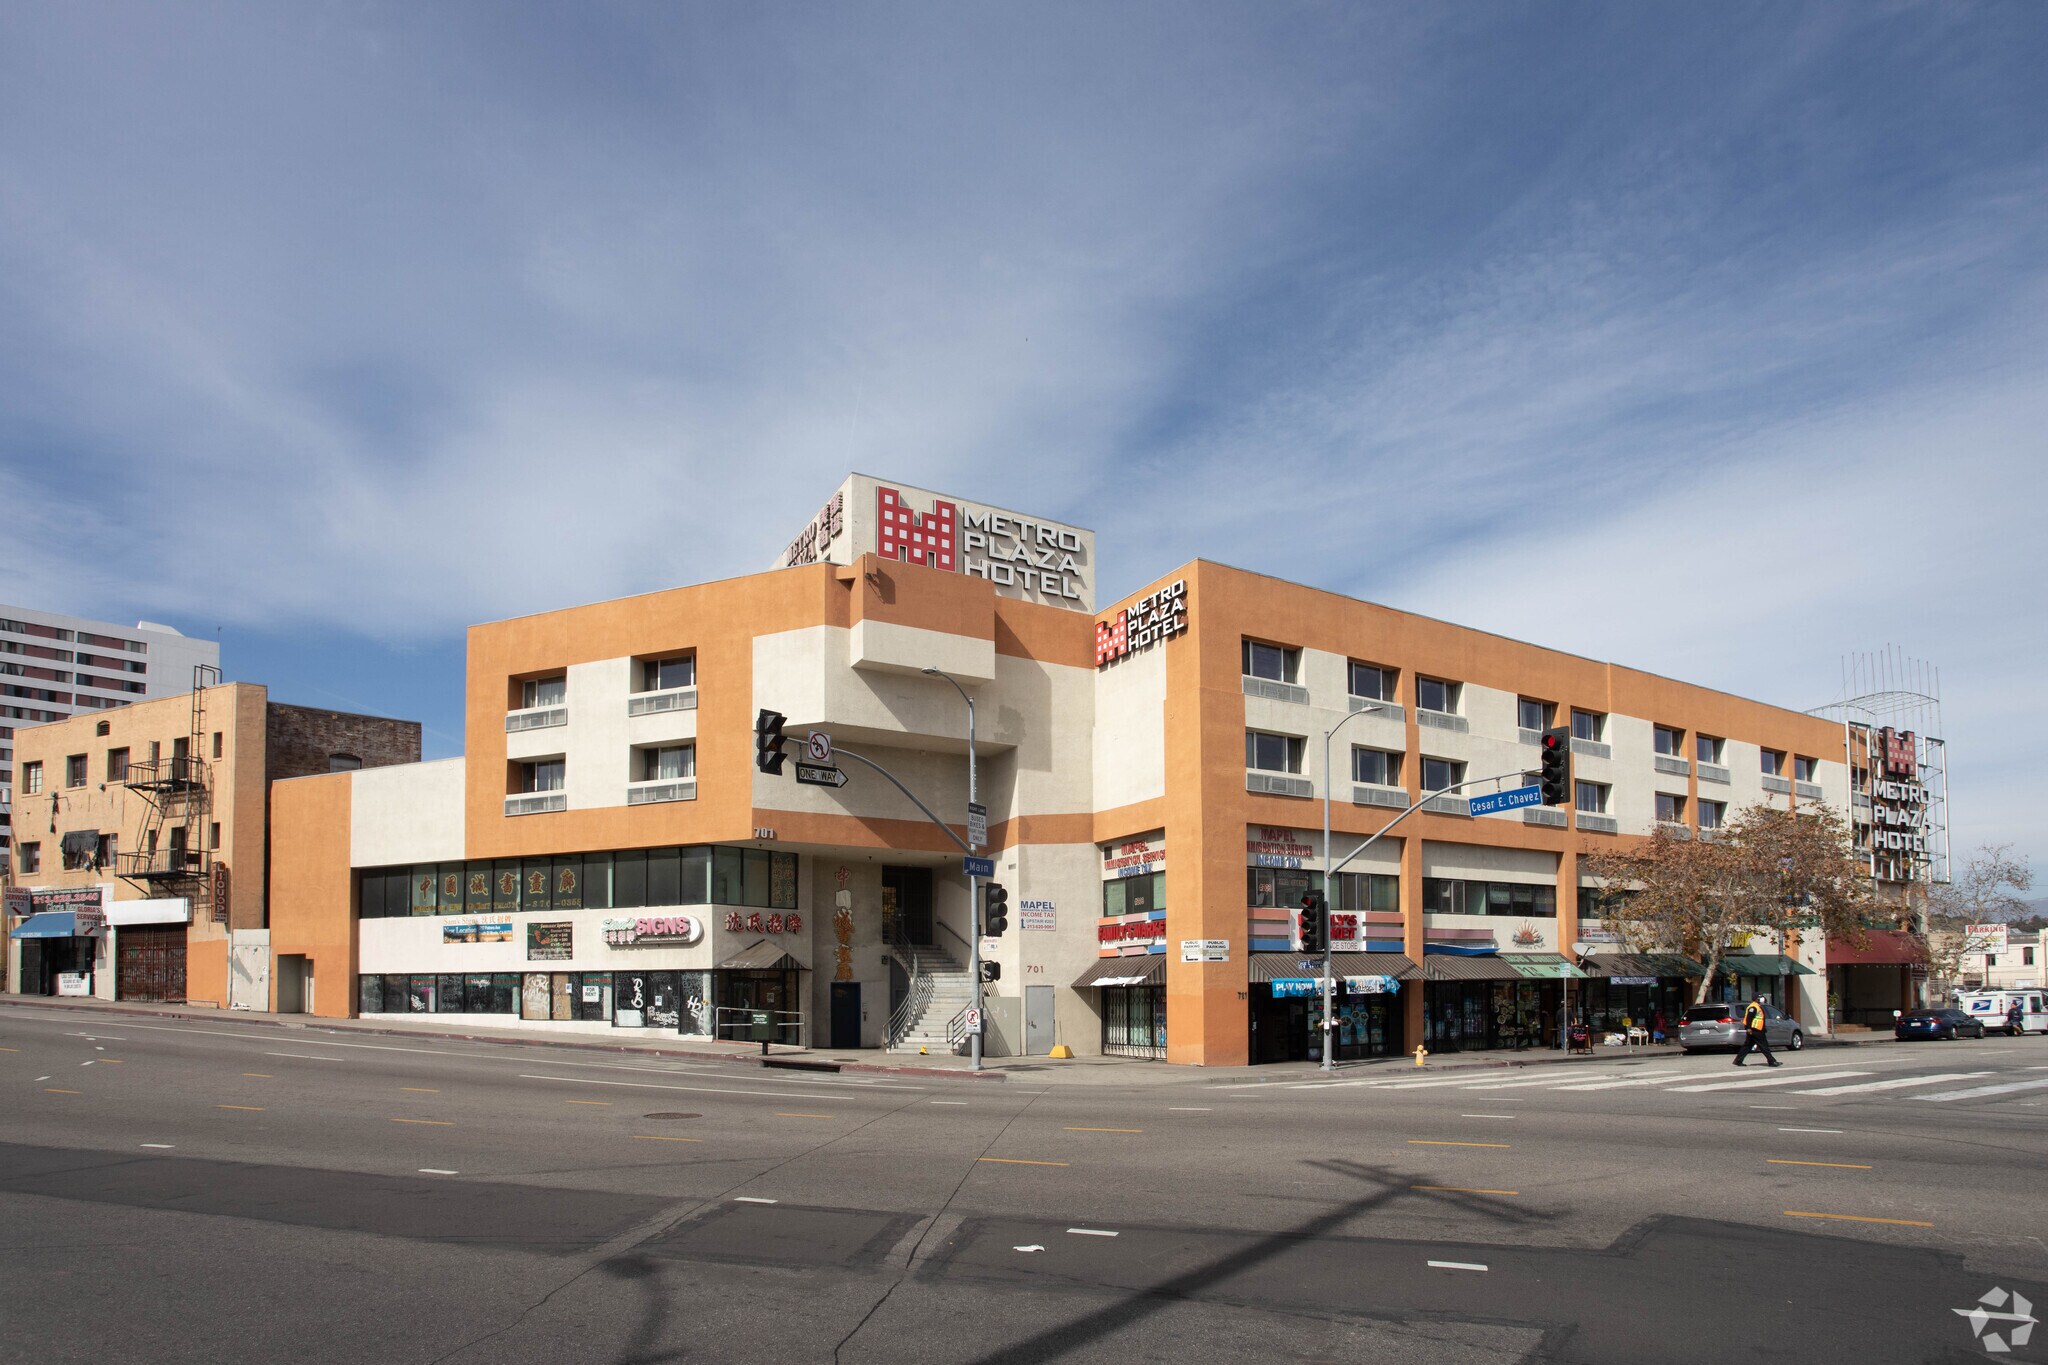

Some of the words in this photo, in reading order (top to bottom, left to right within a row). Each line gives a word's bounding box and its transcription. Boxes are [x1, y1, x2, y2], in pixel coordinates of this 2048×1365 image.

[963, 507, 1081, 552] METRO
[964, 530, 1081, 576] PLAZA
[964, 556, 1081, 600] HOTEL
[1127, 579, 1187, 618] METRO
[1127, 598, 1186, 634] PLAZA
[1127, 616, 1187, 652] HOTEL
[800, 769, 816, 779] ONE
[821, 771, 836, 782] WAY
[1471, 800, 1494, 812] Cesar
[1498, 797, 1506, 807] E.
[1508, 792, 1539, 805] Chavez
[1873, 779, 1931, 804] METRO
[1873, 805, 1931, 829] PLAZA
[754, 828, 774, 839] 701
[1260, 828, 1296, 842] MAPEL
[1874, 830, 1930, 853] HOTEL
[969, 862, 989, 872] Main
[1021, 901, 1054, 909] MAPEL
[635, 917, 690, 934] SIGNS
[725, 912, 802, 934] 沈氏招牌
[1098, 924, 1133, 941] FAMILY'S
[1275, 983, 1294, 992] PLAY
[1295, 982, 1313, 992] NOW
